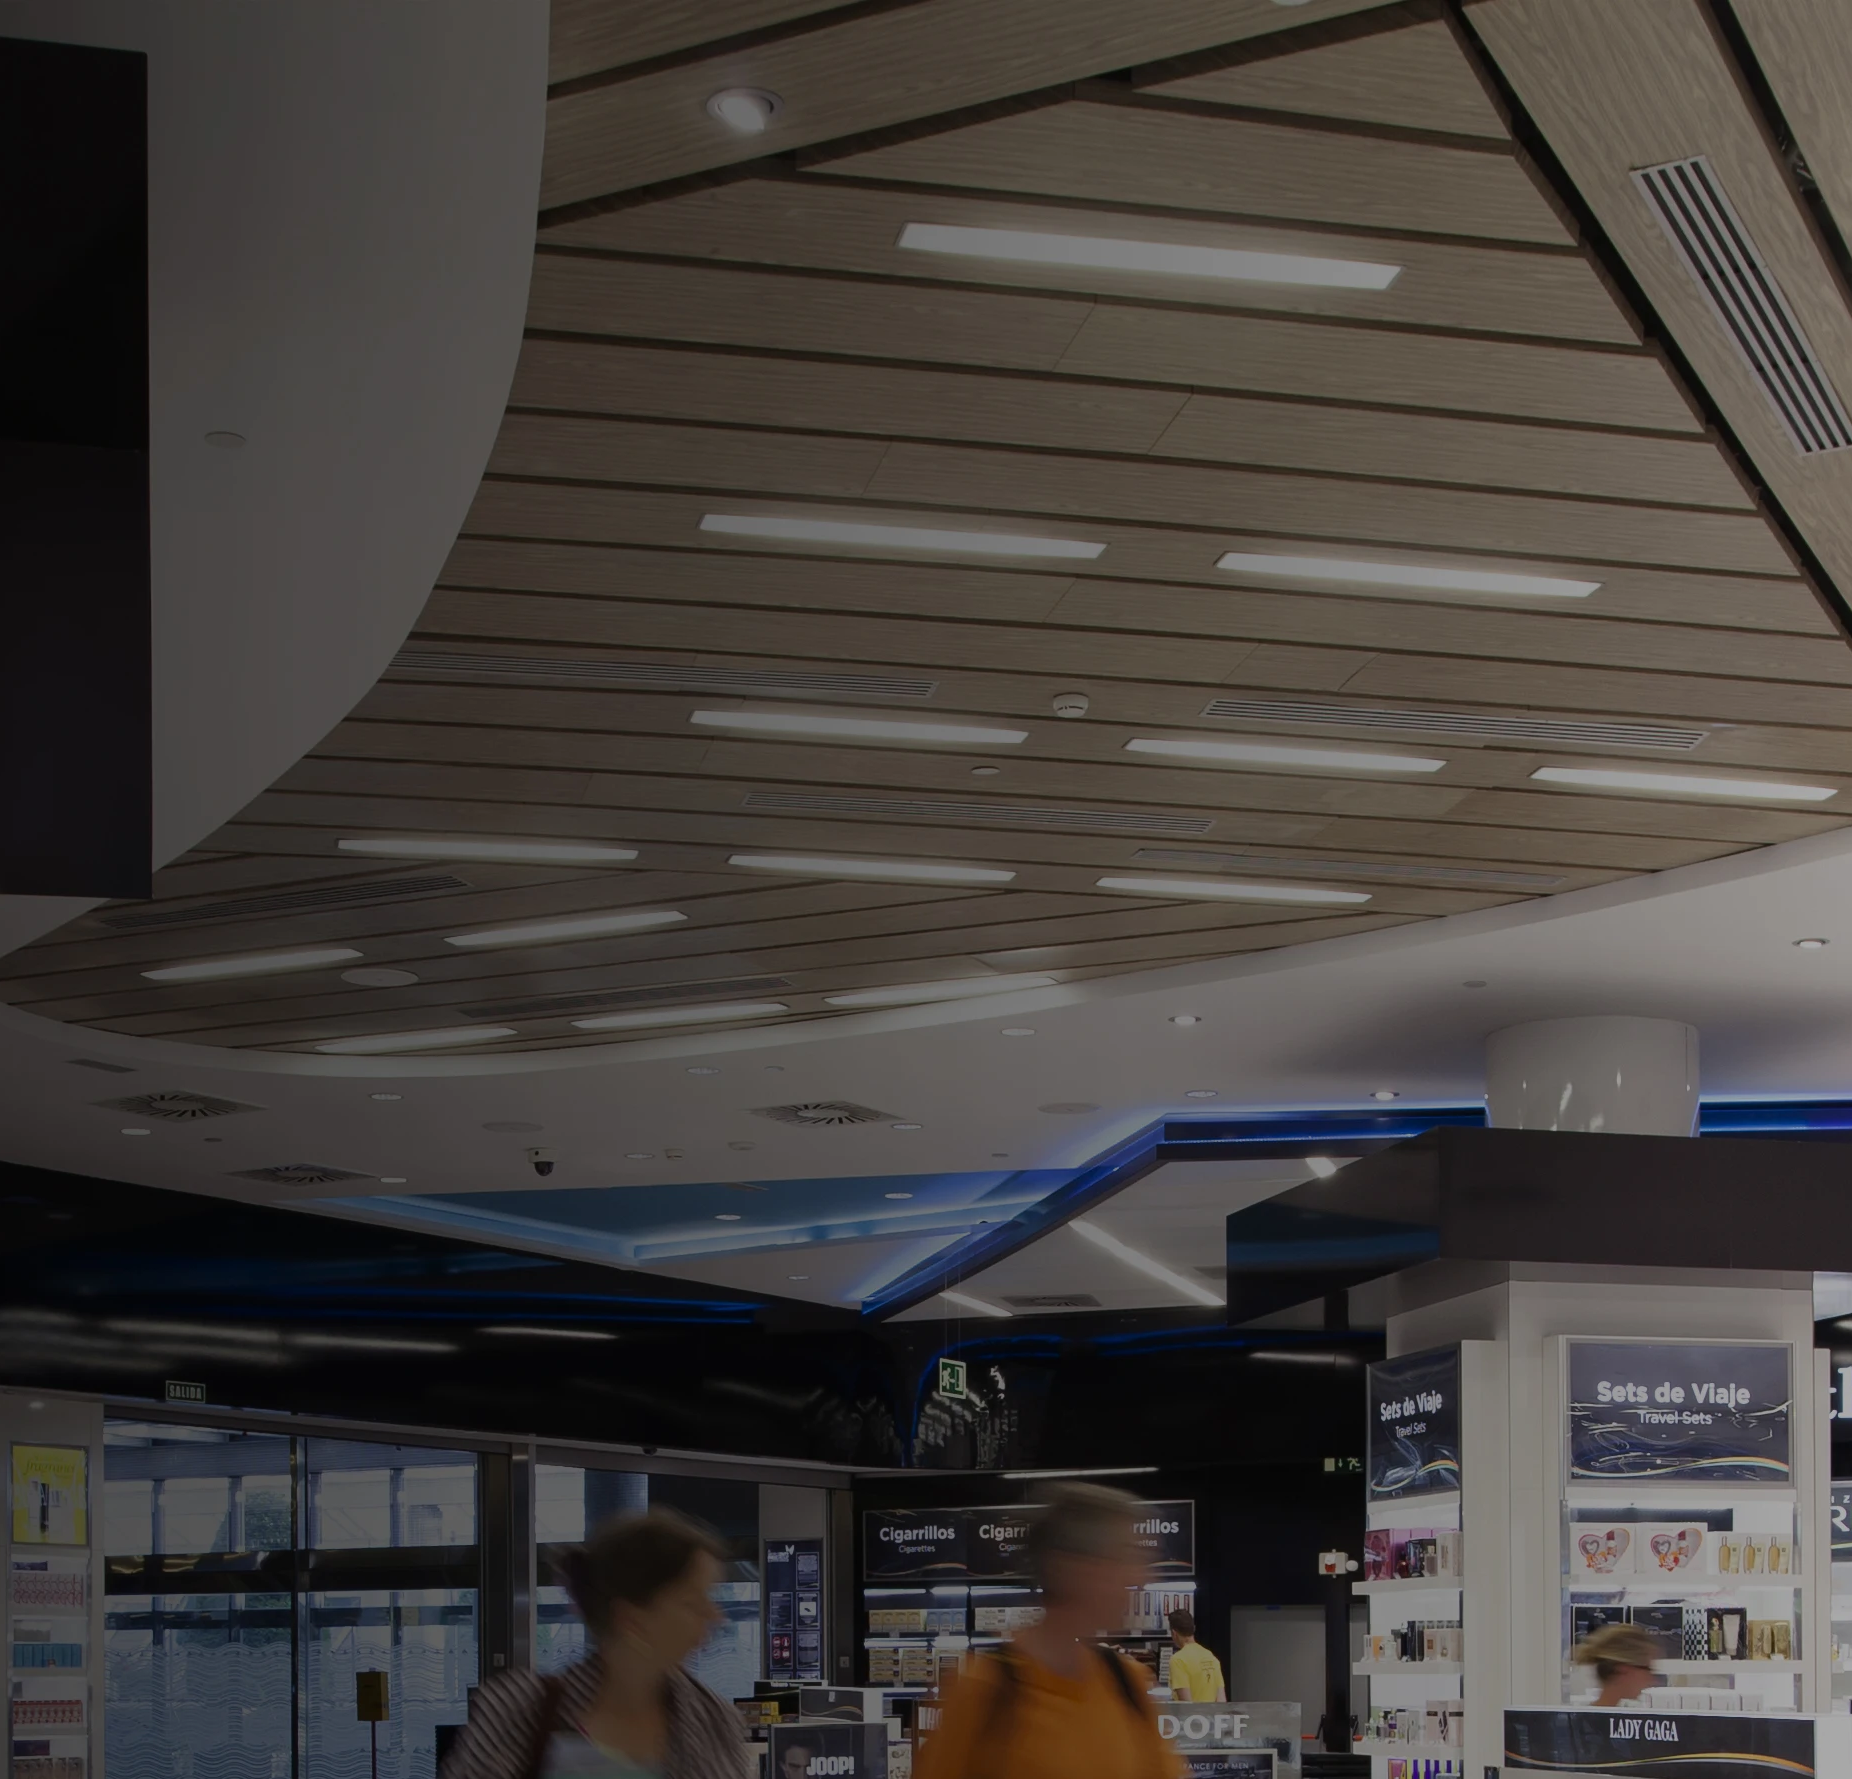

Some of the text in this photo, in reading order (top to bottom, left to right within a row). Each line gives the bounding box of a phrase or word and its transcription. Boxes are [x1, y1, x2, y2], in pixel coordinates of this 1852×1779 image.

[169, 1385, 203, 1400] SALIDA
[1596, 1380, 1751, 1407] Sets de Viaje
[1380, 1390, 1443, 1421] Sets de Viaje
[1638, 1410, 1712, 1426] Travel Sets
[1395, 1421, 1427, 1438] Travel Sets
[879, 1527, 955, 1543] Cigarrillos
[1133, 1519, 1179, 1534] rrillos
[898, 1545, 936, 1554] Cigarettes
[1158, 1714, 1249, 1739] DOFF
[1609, 1719, 1679, 1742] LADY GAGA
[806, 1755, 855, 1776] JOOP!
